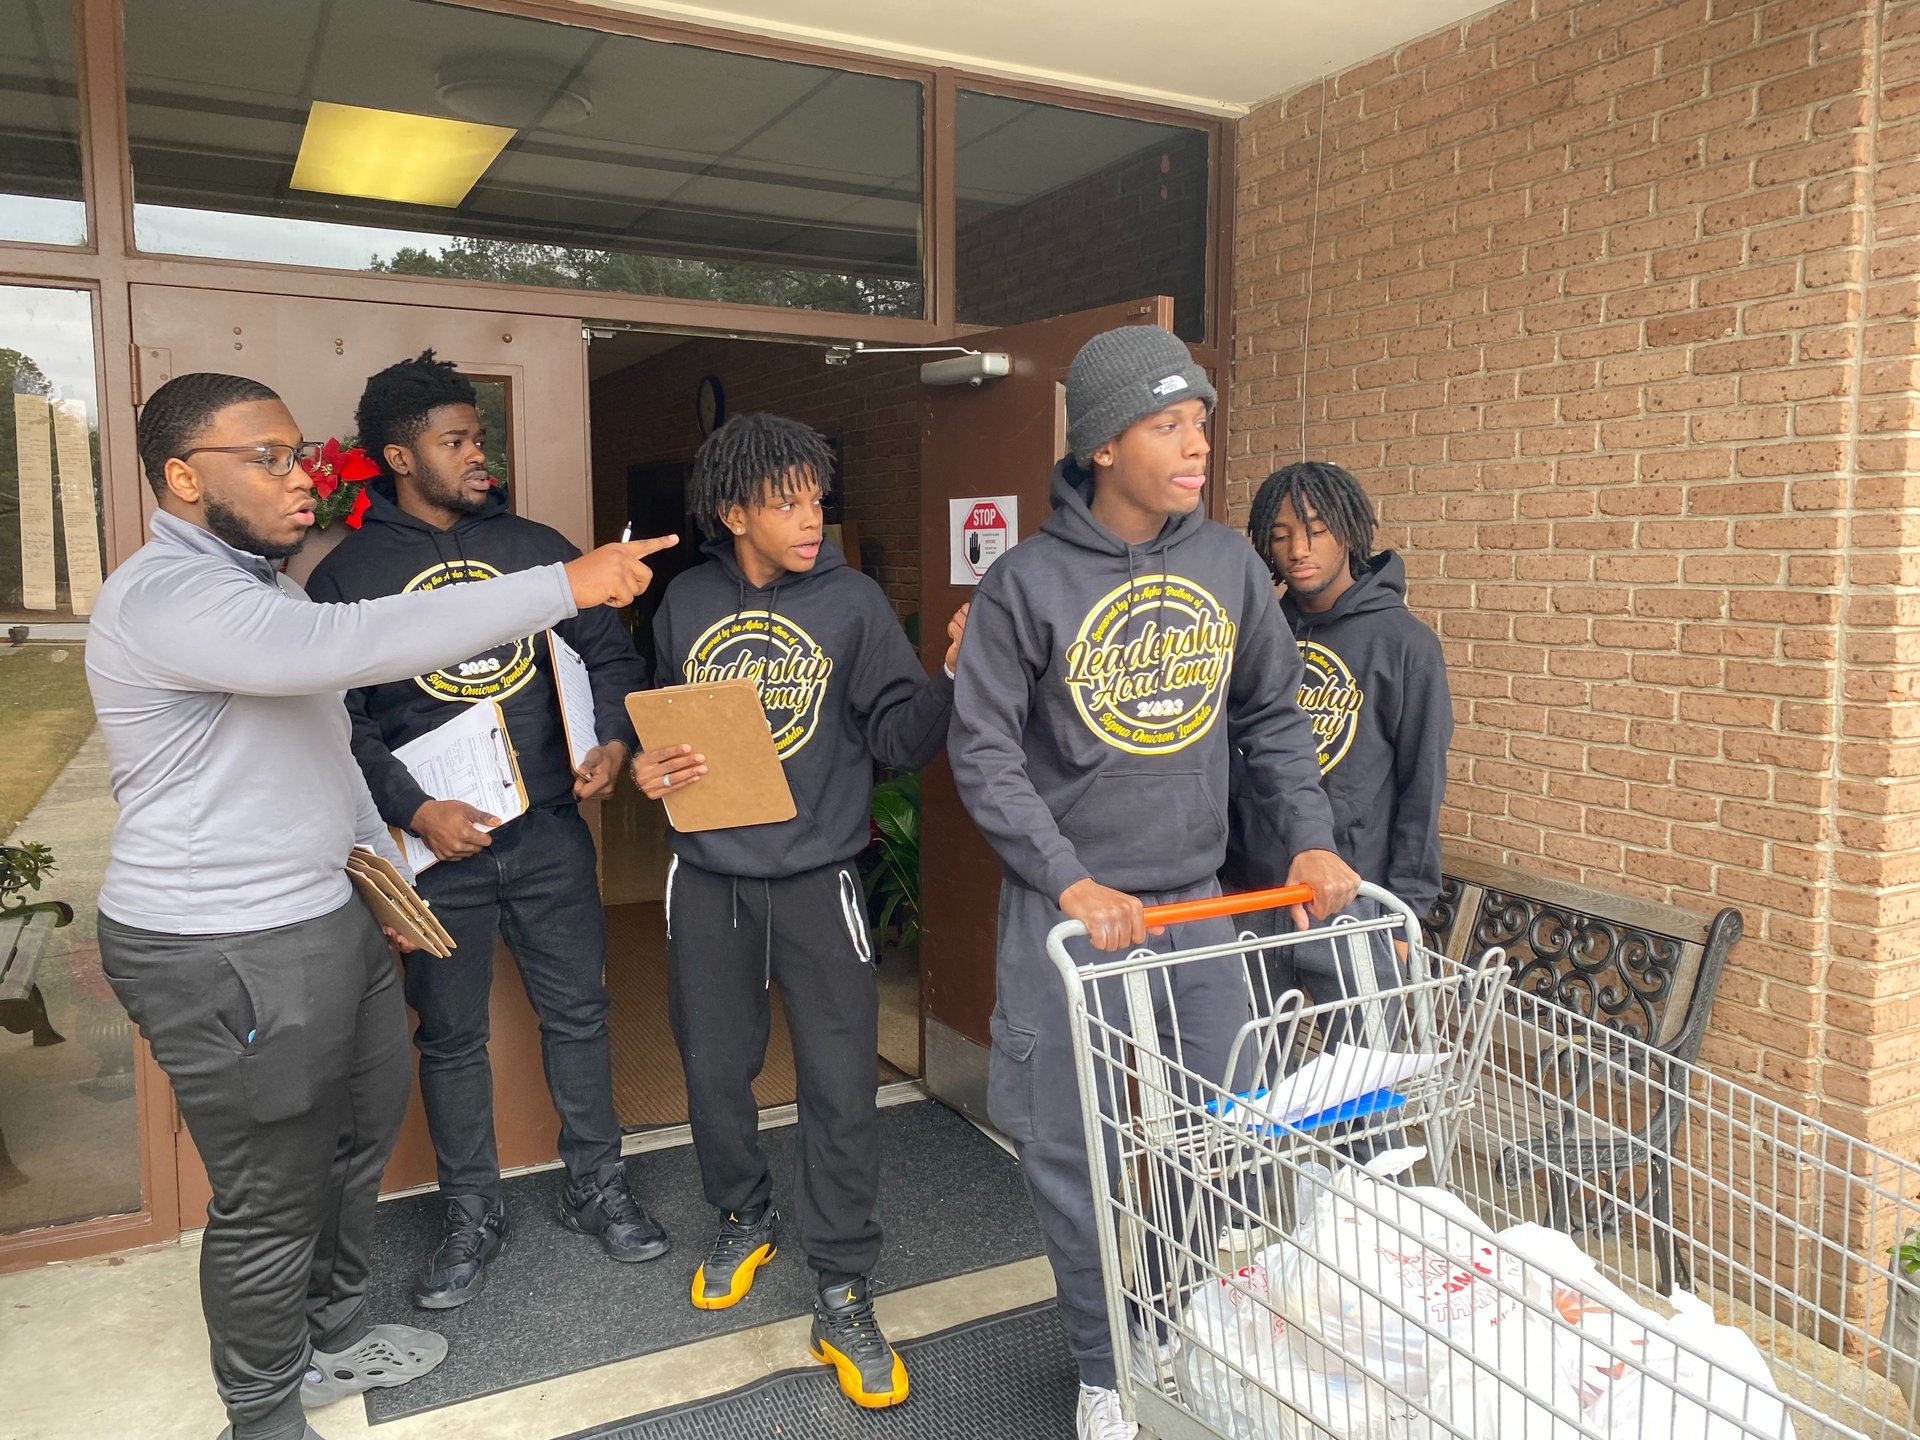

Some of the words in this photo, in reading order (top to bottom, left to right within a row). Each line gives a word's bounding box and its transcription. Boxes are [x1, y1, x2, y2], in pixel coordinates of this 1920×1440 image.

[973, 508, 996, 526] STOP
[1165, 585, 1195, 603] Brothers
[1192, 598, 1205, 609] of
[458, 657, 501, 677] 2023
[1065, 608, 1236, 690] Leadership
[427, 673, 459, 694] Sigma
[461, 683, 500, 696] Omicron
[500, 656, 530, 688] Lambda
[1089, 653, 1224, 712] Academy
[1099, 712, 1131, 739] Sigma
[1131, 728, 1175, 744] Omicron
[1176, 705, 1212, 740] Lambda
